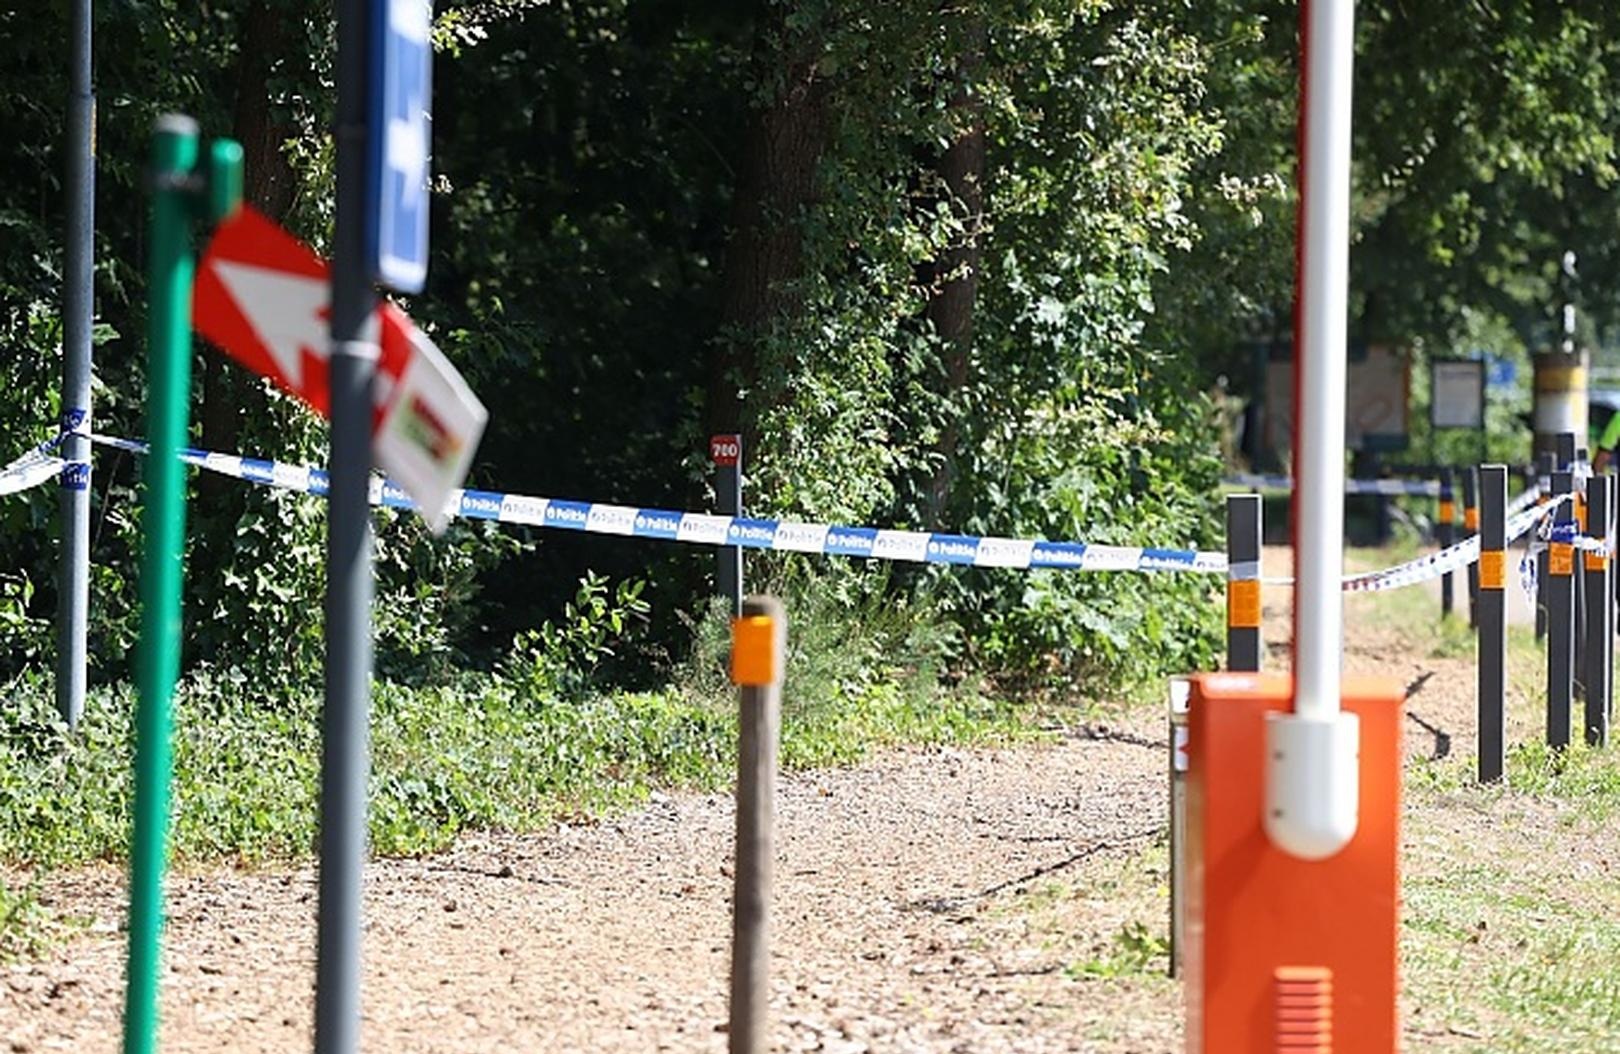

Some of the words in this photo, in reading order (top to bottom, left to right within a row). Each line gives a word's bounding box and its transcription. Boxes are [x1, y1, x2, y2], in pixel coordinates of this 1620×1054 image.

[556, 507, 587, 522] Politie
[646, 517, 678, 531] Politie
[740, 526, 774, 541] Politie
[838, 534, 873, 549] Politie
[940, 541, 976, 557] Politie
